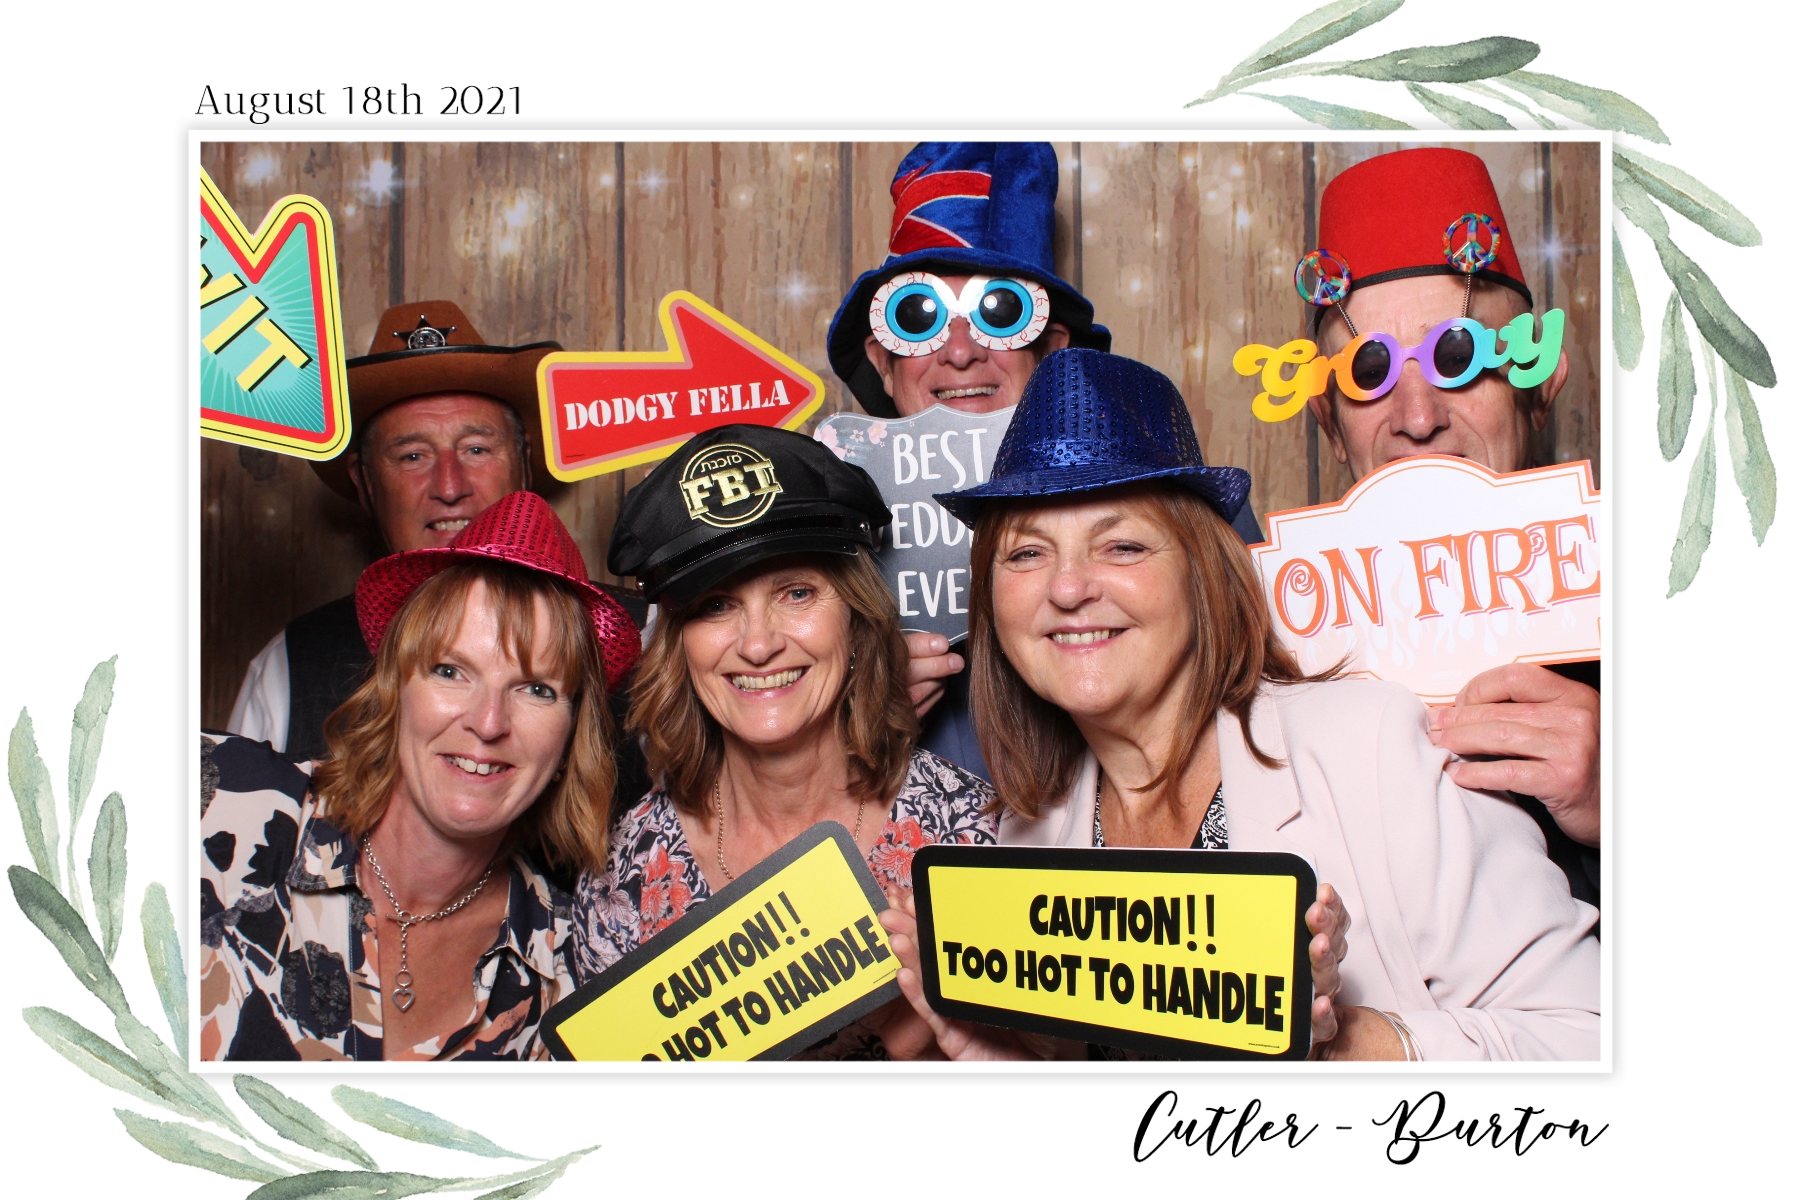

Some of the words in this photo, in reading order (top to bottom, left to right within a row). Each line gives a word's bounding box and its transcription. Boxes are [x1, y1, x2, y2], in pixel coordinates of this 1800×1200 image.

[563, 391, 677, 431] DODGY
[687, 379, 790, 417] FELLA
[680, 459, 783, 519] FBI
[893, 428, 988, 489] BEST
[897, 566, 972, 618] EVE
[1274, 546, 1384, 638] ON
[1400, 514, 1600, 620] FIRE
[652, 890, 811, 1019] CAUTION!!
[1029, 894, 1217, 955] CAUTION!!
[661, 1010, 729, 1062] HOT
[720, 995, 772, 1037] TO
[762, 914, 892, 1017] HANDLE
[942, 941, 1008, 984] TOO
[1015, 949, 1081, 996] HOT
[1089, 957, 1135, 1005] TO
[1142, 963, 1285, 1032] HANDLE
